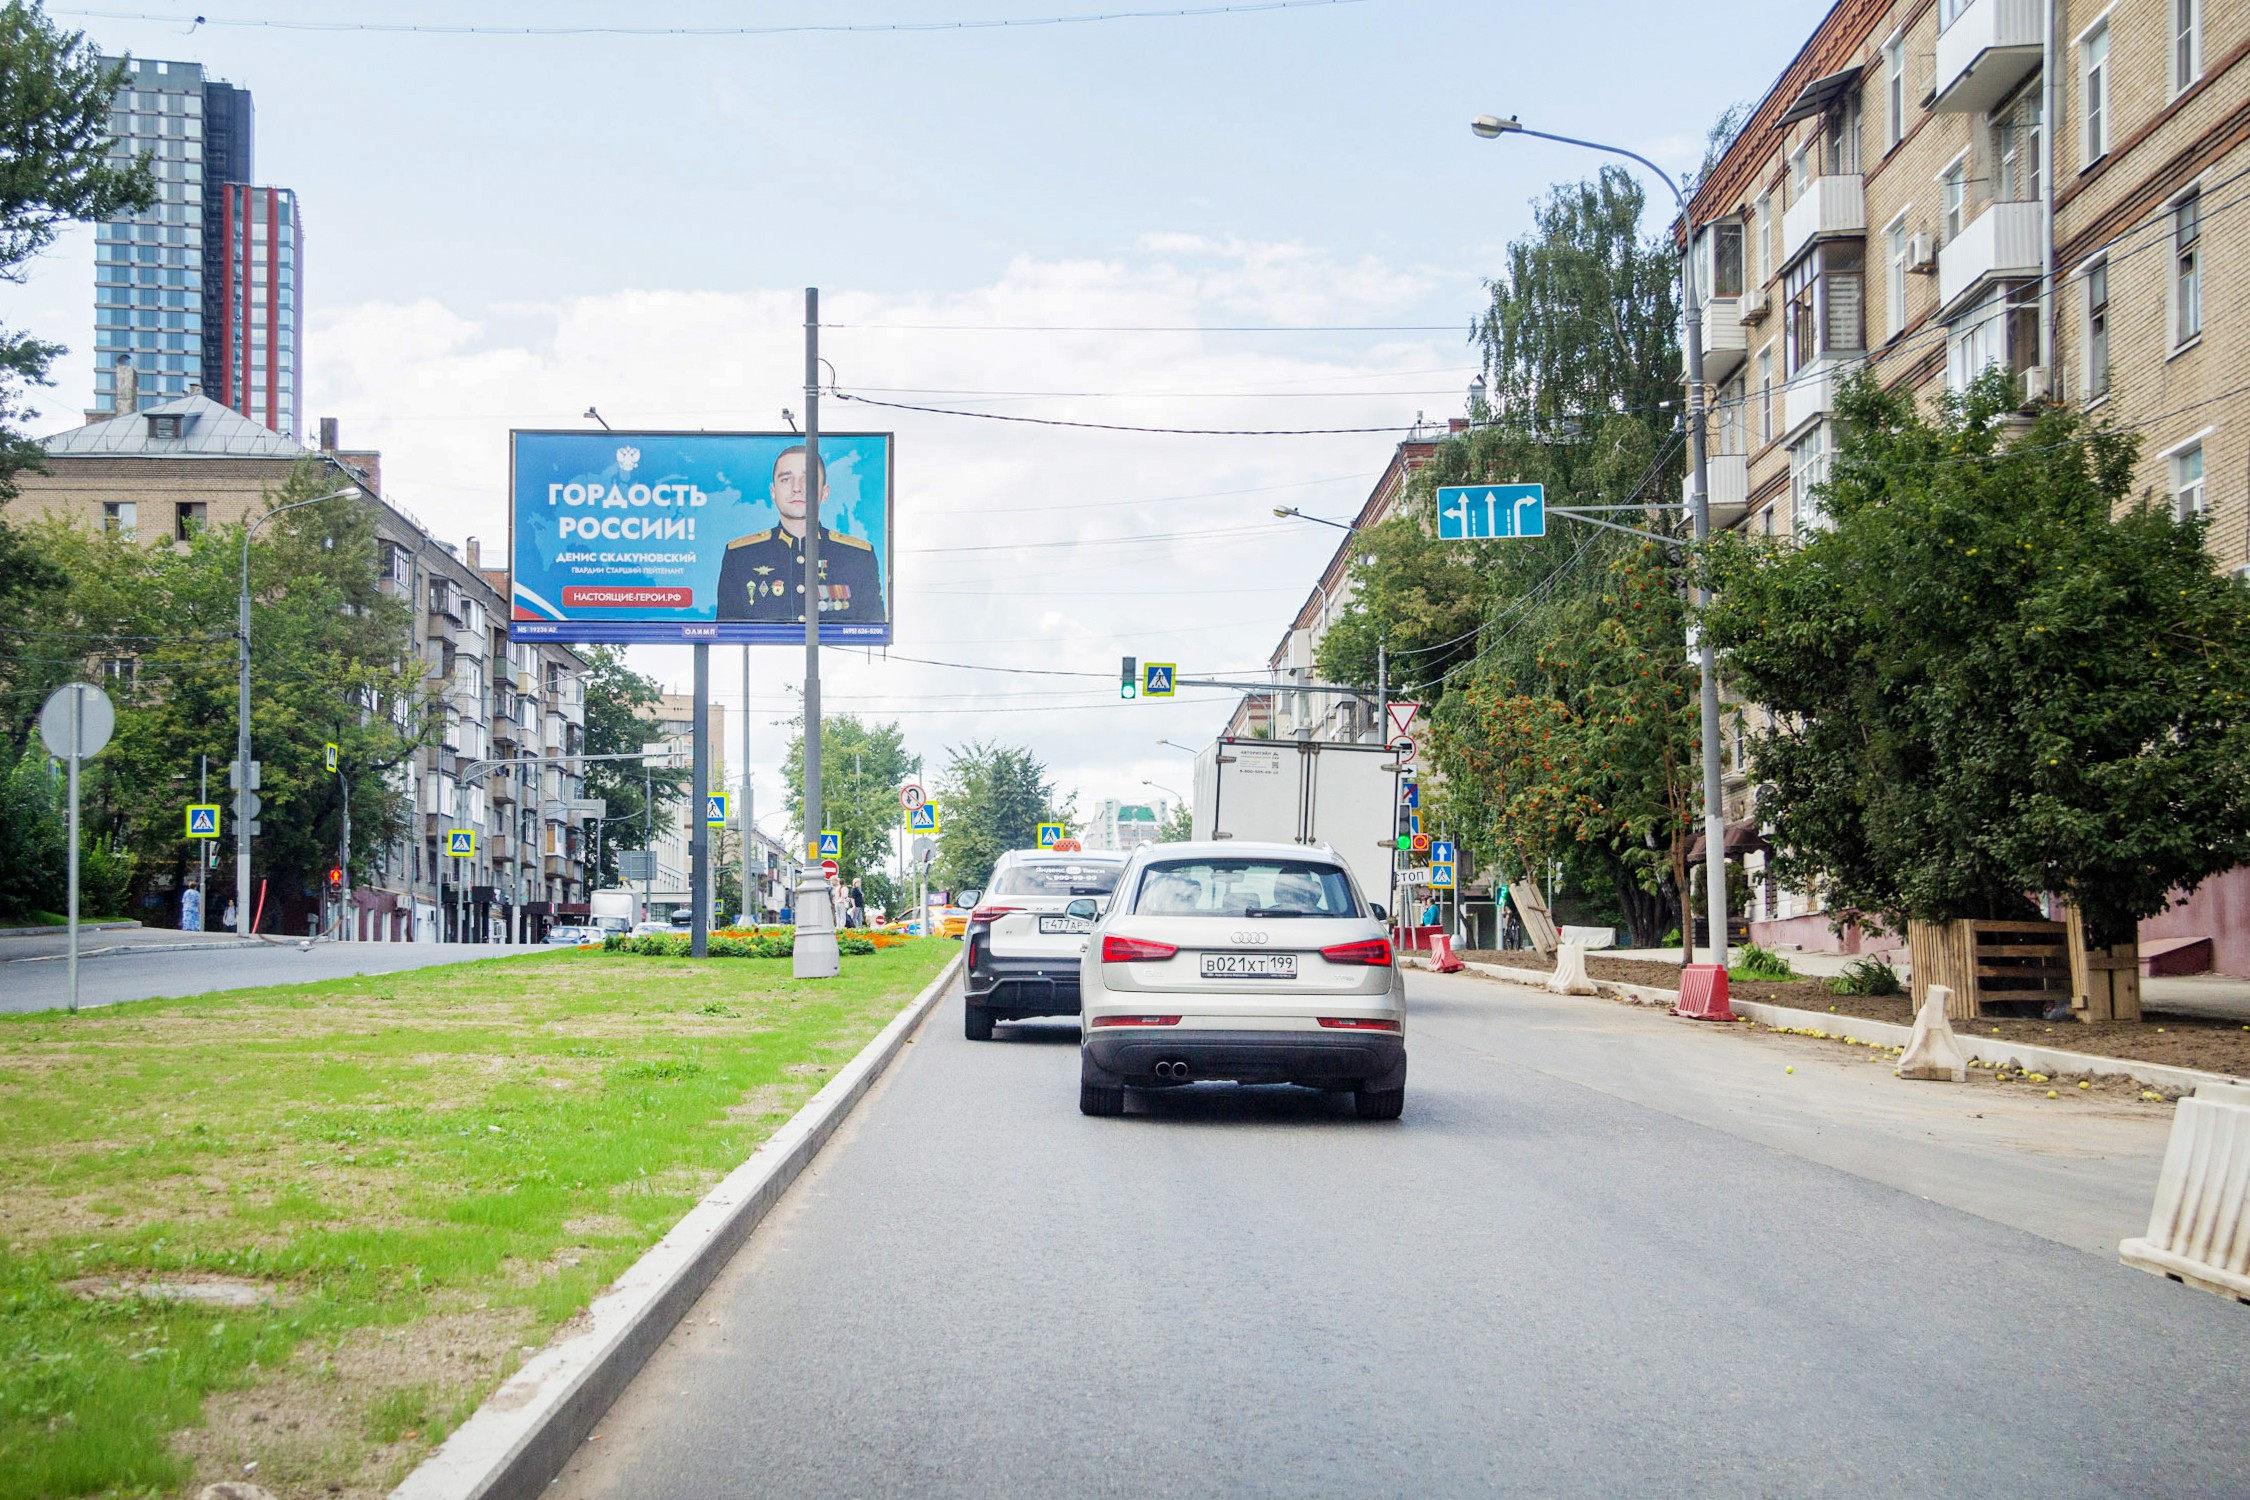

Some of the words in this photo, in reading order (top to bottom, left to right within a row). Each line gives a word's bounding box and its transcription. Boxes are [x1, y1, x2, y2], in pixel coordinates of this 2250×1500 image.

[548, 483, 708, 508] ГОРДОСТЬ
[559, 517, 696, 540] РОССИИ!
[555, 552, 597, 563] ДЕНИС
[599, 551, 697, 563] СКАКУНОВСКИЙ
[571, 566, 604, 575] ГВАРДИИ
[605, 566, 641, 575] СТАРШИЙ
[643, 566, 684, 575] ЛЕЙТЕНАНТ
[573, 591, 682, 603] НАСТОЯЩИЕ-ГЕРОИ.РФ
[685, 628, 716, 636] ОЛИМП
[1270, 957, 1293, 969] 199
